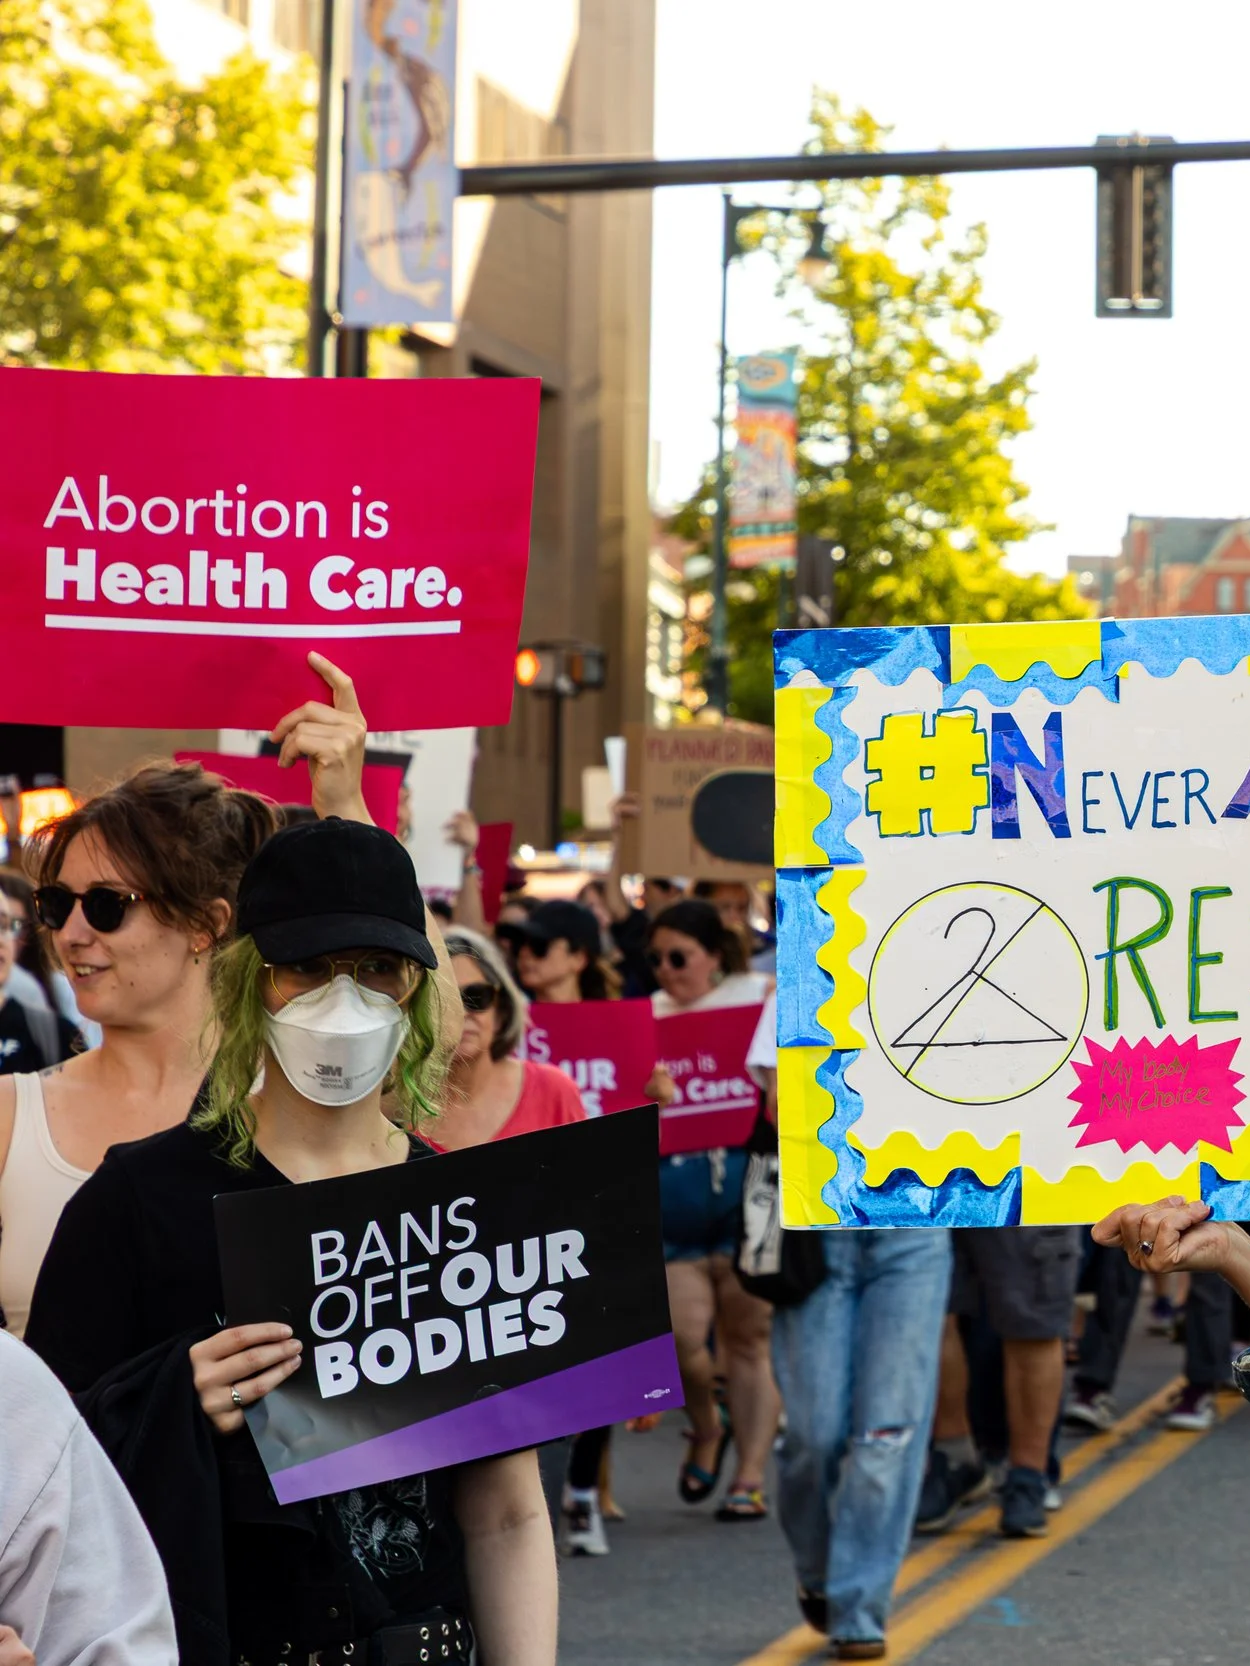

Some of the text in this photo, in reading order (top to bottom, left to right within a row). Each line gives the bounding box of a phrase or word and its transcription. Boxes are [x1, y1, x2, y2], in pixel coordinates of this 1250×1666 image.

[43, 475, 390, 540] Abortion is
[44, 546, 464, 612] Health Care.
[315, 1064, 343, 1077] 3M
[1099, 1059, 1133, 1096] My
[1099, 1092, 1133, 1120] My
[310, 1195, 478, 1286] BANS
[309, 1229, 590, 1340] OFF OUR
[313, 1290, 567, 1400] BODIES
